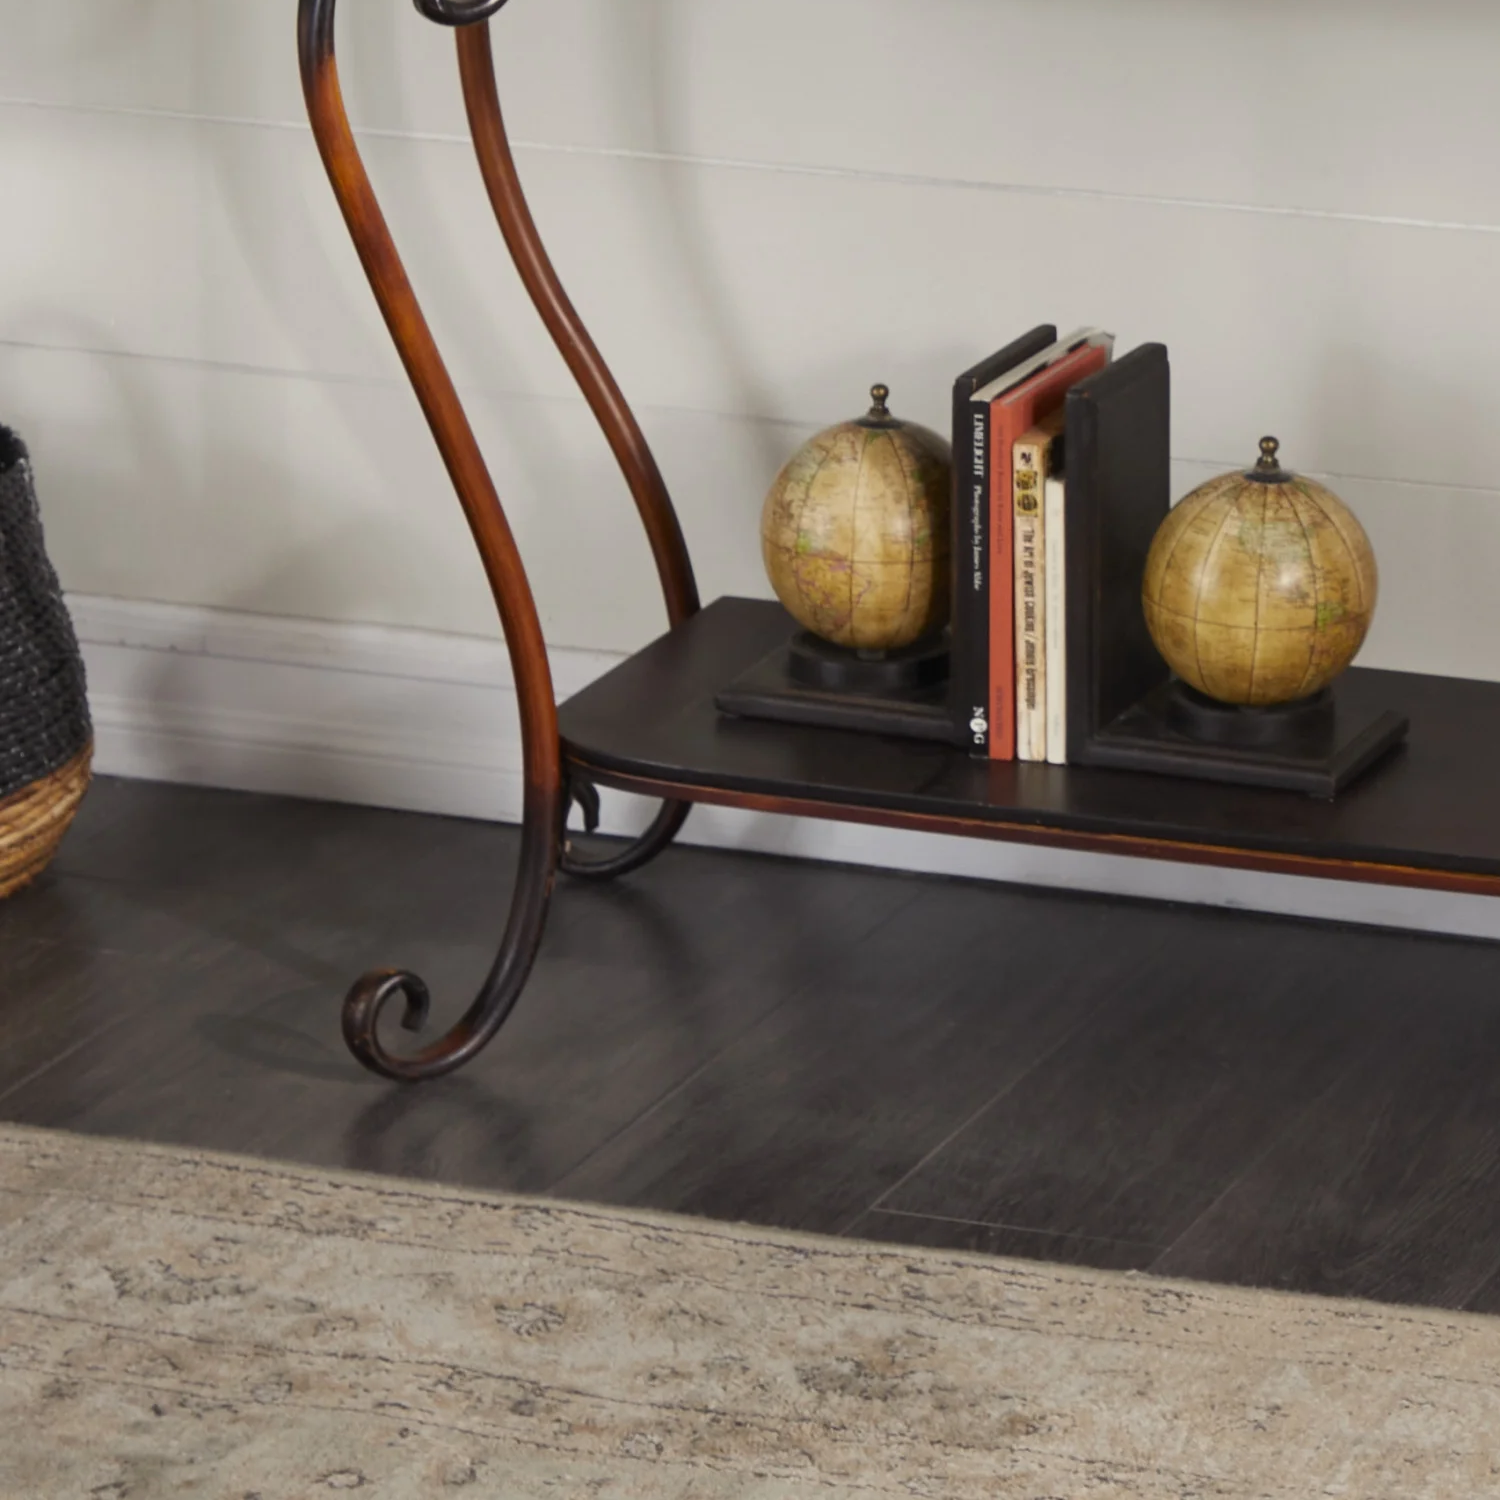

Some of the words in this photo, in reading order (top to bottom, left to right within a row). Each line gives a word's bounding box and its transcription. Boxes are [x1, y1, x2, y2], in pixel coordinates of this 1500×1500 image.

[973, 413, 985, 478] LIMELIGHT
[1023, 529, 1034, 543] The
[1023, 546, 1034, 558] Art
[1023, 570, 1035, 598] Jewish
[1024, 601, 1036, 631] Cooking
